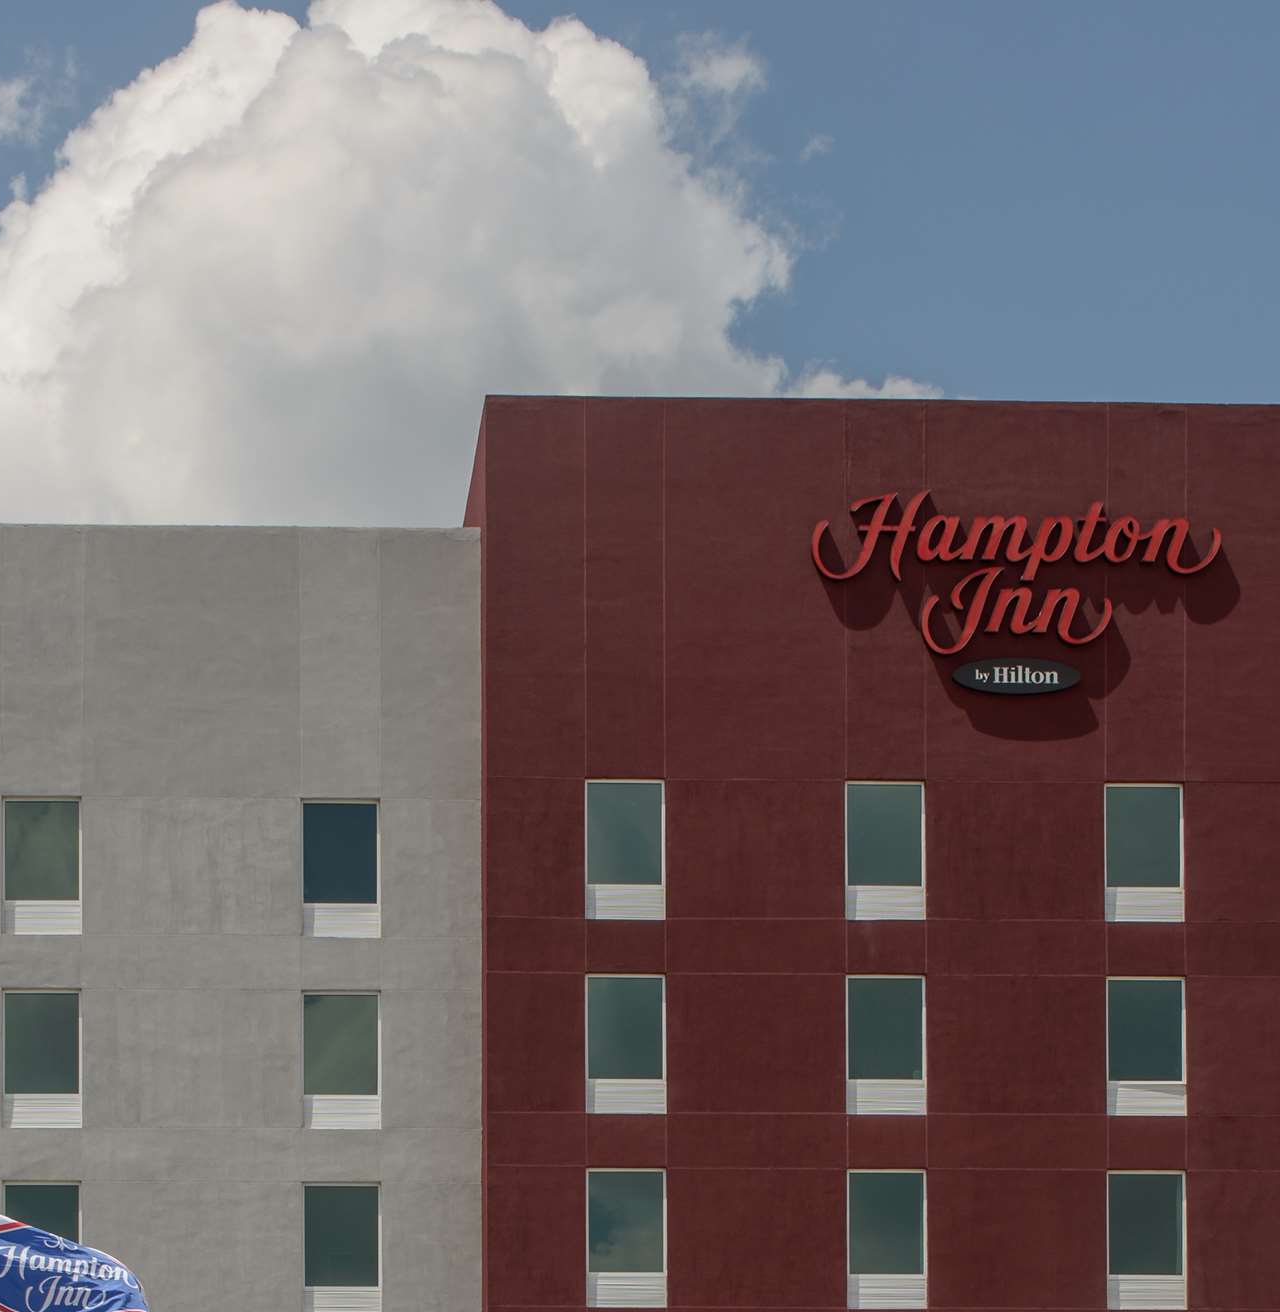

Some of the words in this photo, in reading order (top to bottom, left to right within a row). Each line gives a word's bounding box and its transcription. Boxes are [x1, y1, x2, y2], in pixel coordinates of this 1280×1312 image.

[811, 489, 1221, 582] Hampton
[922, 566, 1113, 655] Inn
[975, 668, 990, 683] by
[993, 665, 1059, 684] Hilton
